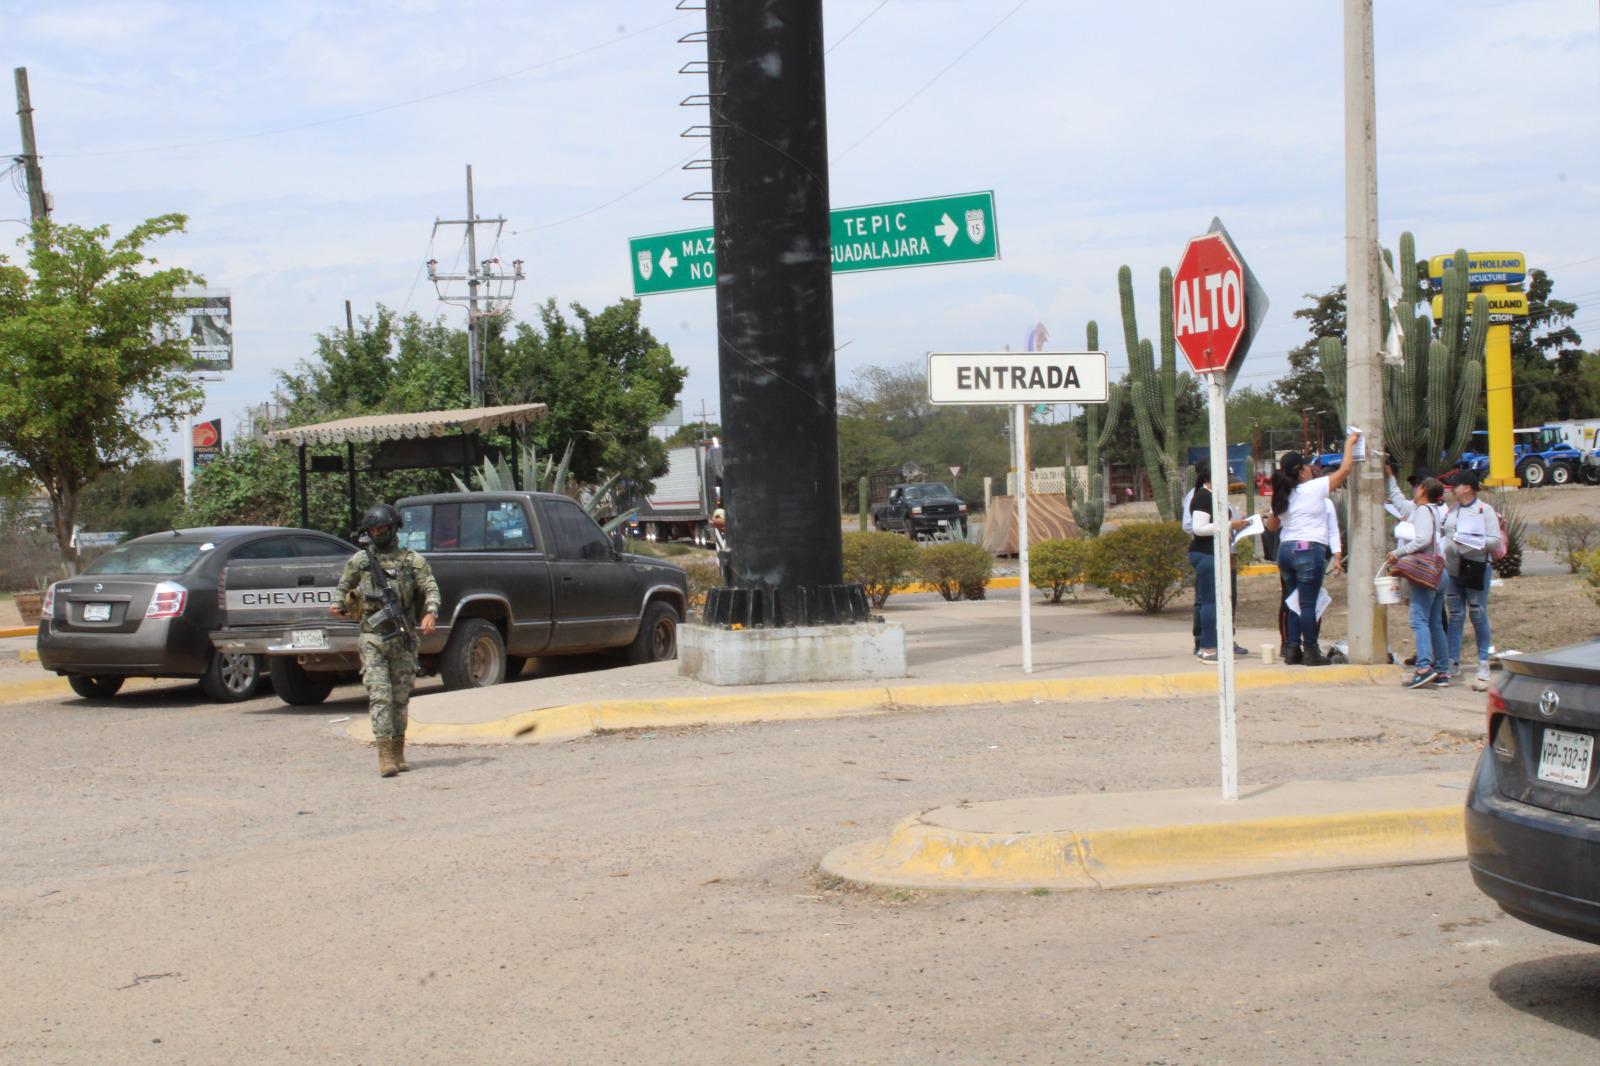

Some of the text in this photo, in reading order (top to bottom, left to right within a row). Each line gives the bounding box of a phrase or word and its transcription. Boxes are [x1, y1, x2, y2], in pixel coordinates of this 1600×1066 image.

[843, 212, 907, 237] TEPIC
[971, 223, 982, 236] 15
[690, 261, 713, 280] NO
[1480, 259, 1520, 269] HOLLAND
[1176, 269, 1242, 337] ALTO
[1488, 300, 1522, 309] OLLAND
[956, 365, 1081, 390] ENTRADA
